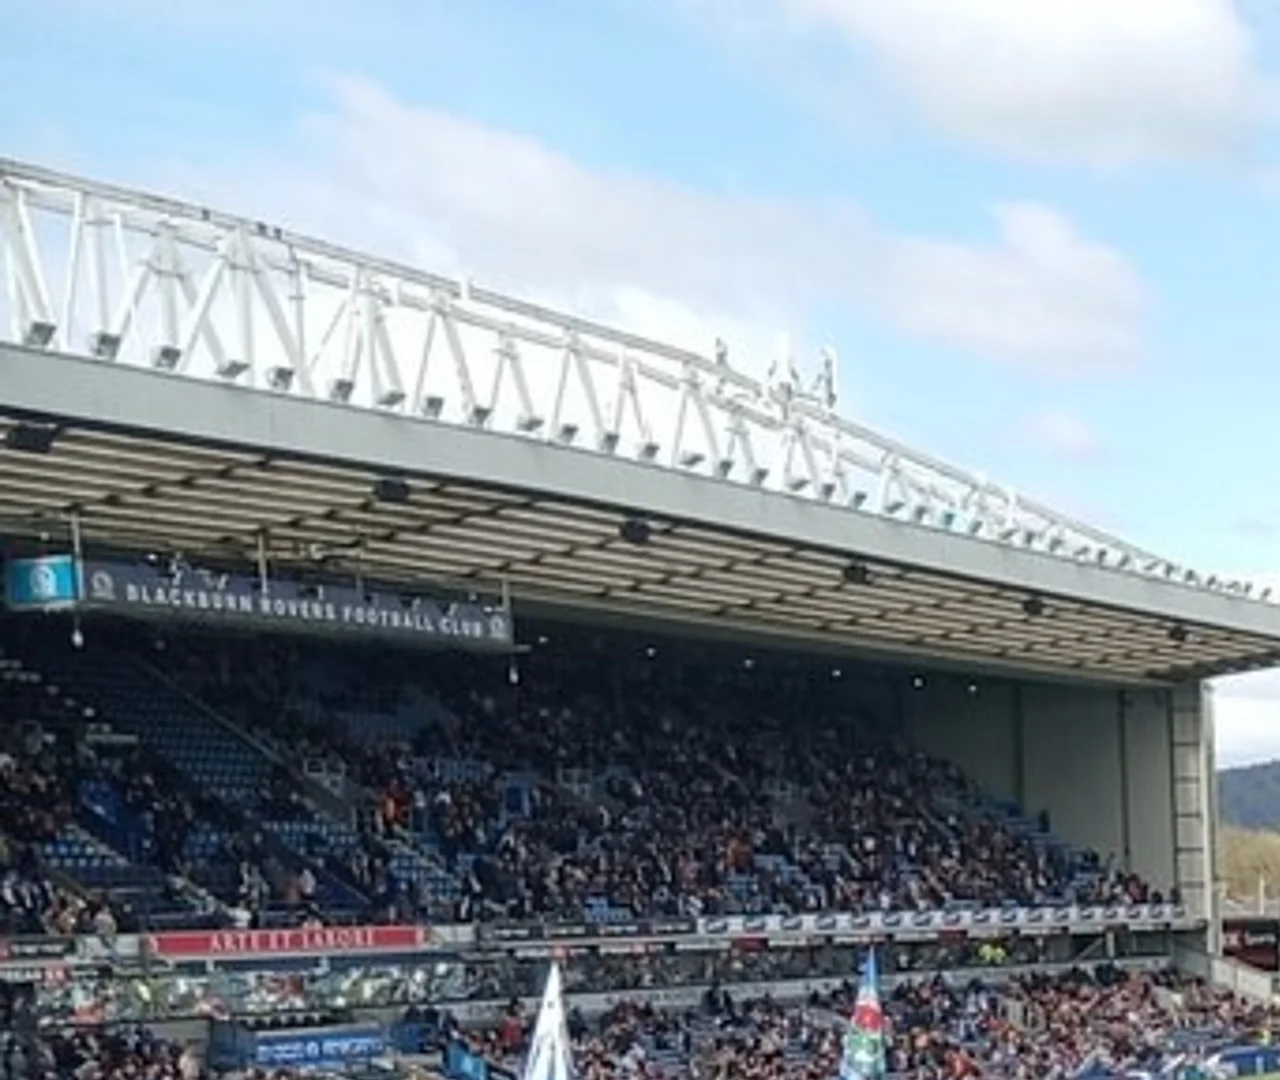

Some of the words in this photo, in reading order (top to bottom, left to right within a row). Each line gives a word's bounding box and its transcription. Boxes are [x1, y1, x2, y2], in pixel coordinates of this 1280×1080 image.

[126, 584, 252, 613] BLACKBURN
[261, 595, 336, 620] ROVERS
[342, 605, 435, 633] FOOTBALL
[438, 617, 484, 638] CLUB
[208, 931, 260, 952] ARTE
[269, 931, 292, 950] ET
[302, 929, 375, 950] LABORE
